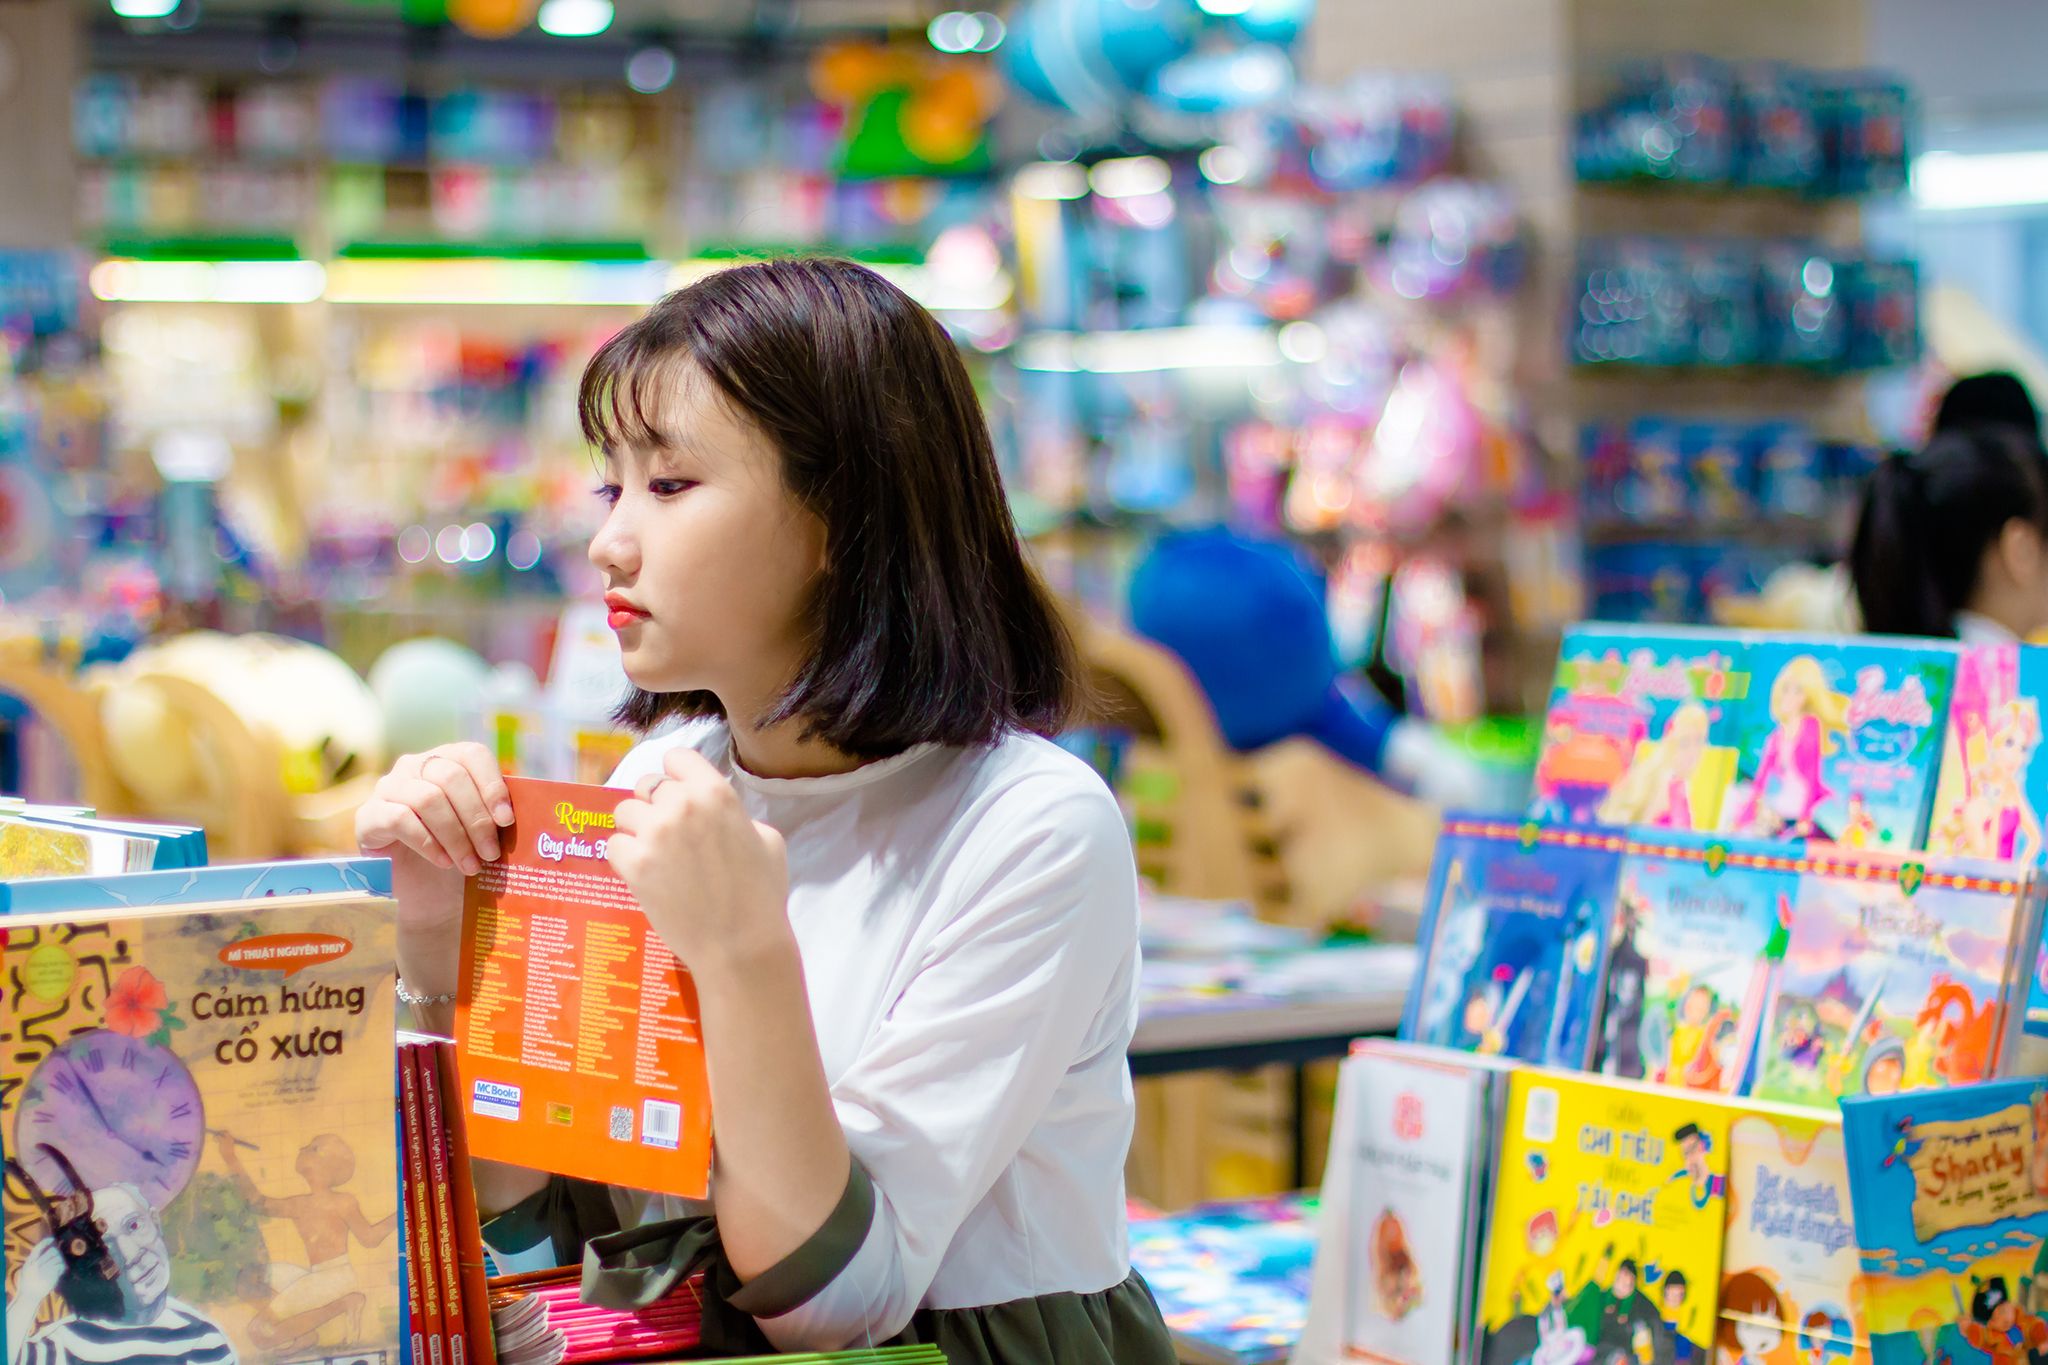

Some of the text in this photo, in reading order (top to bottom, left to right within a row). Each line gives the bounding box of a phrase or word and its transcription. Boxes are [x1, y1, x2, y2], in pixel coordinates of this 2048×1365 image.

[555, 801, 616, 834] Rapunz
[537, 832, 609, 862] Công chúa T
[191, 980, 365, 1020] Cảm hứng
[215, 1020, 344, 1066] cổ xưa
[404, 1066, 412, 1090] Around
[409, 1103, 417, 1126] World
[424, 1067, 433, 1091] Around
[429, 1104, 438, 1128] World
[477, 1083, 518, 1099] MC Books
[1923, 1141, 2024, 1198] Sharky
[424, 1262, 436, 1287] quanh
[444, 1264, 456, 1288] quanh
[428, 1288, 437, 1300] thế
[449, 1288, 458, 1301] thế
